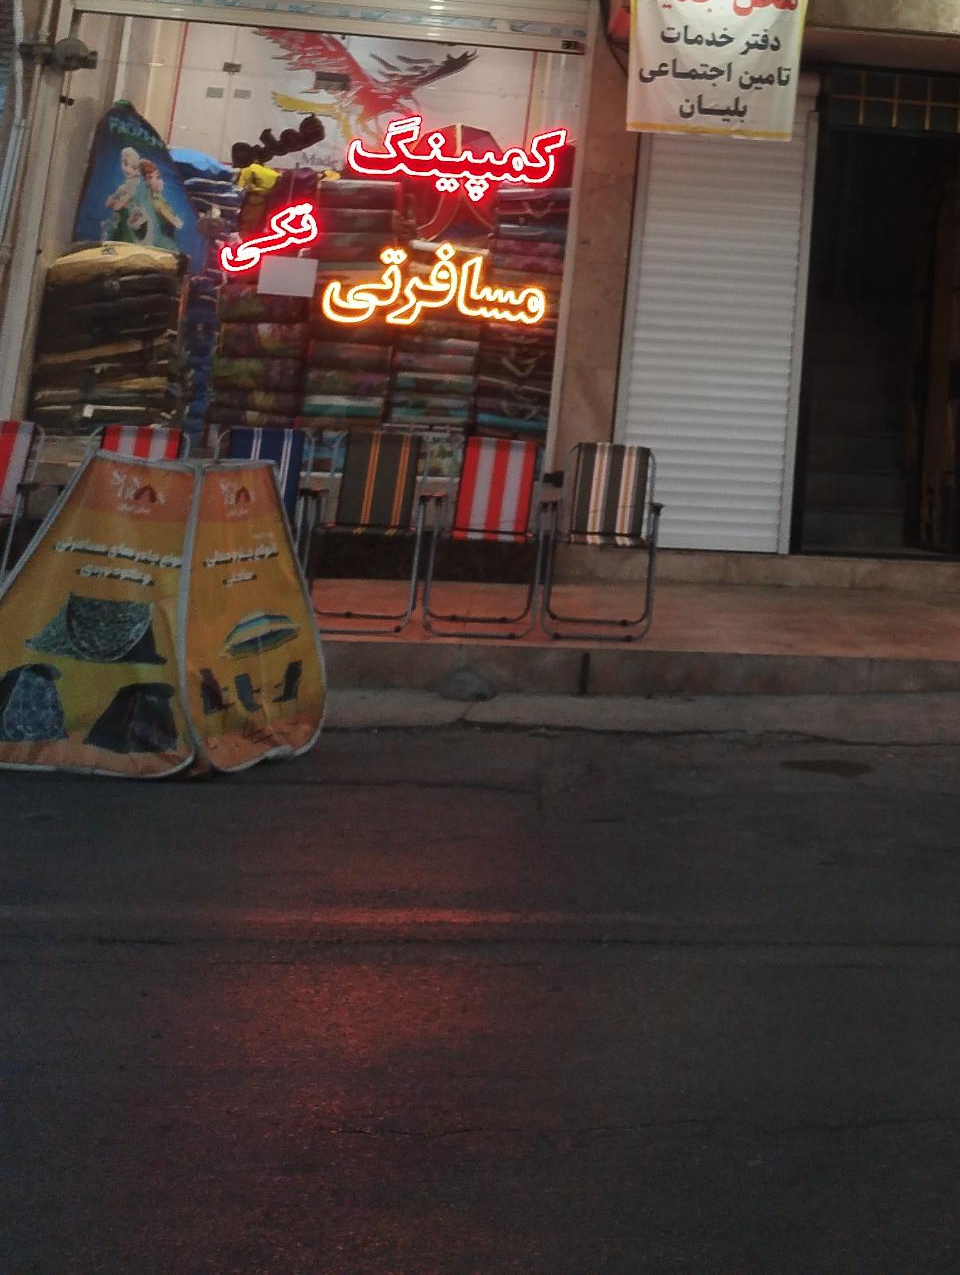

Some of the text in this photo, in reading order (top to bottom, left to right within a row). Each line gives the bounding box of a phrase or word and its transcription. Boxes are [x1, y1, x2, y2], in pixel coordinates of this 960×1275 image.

[661, 25, 780, 55] دفتر خدمات
[639, 58, 791, 90] تامین اجتماعی
[679, 95, 748, 123] بلیان
[347, 114, 568, 203] کمپینگ
[219, 202, 319, 273] تکی
[321, 241, 546, 325] مسافرتی
